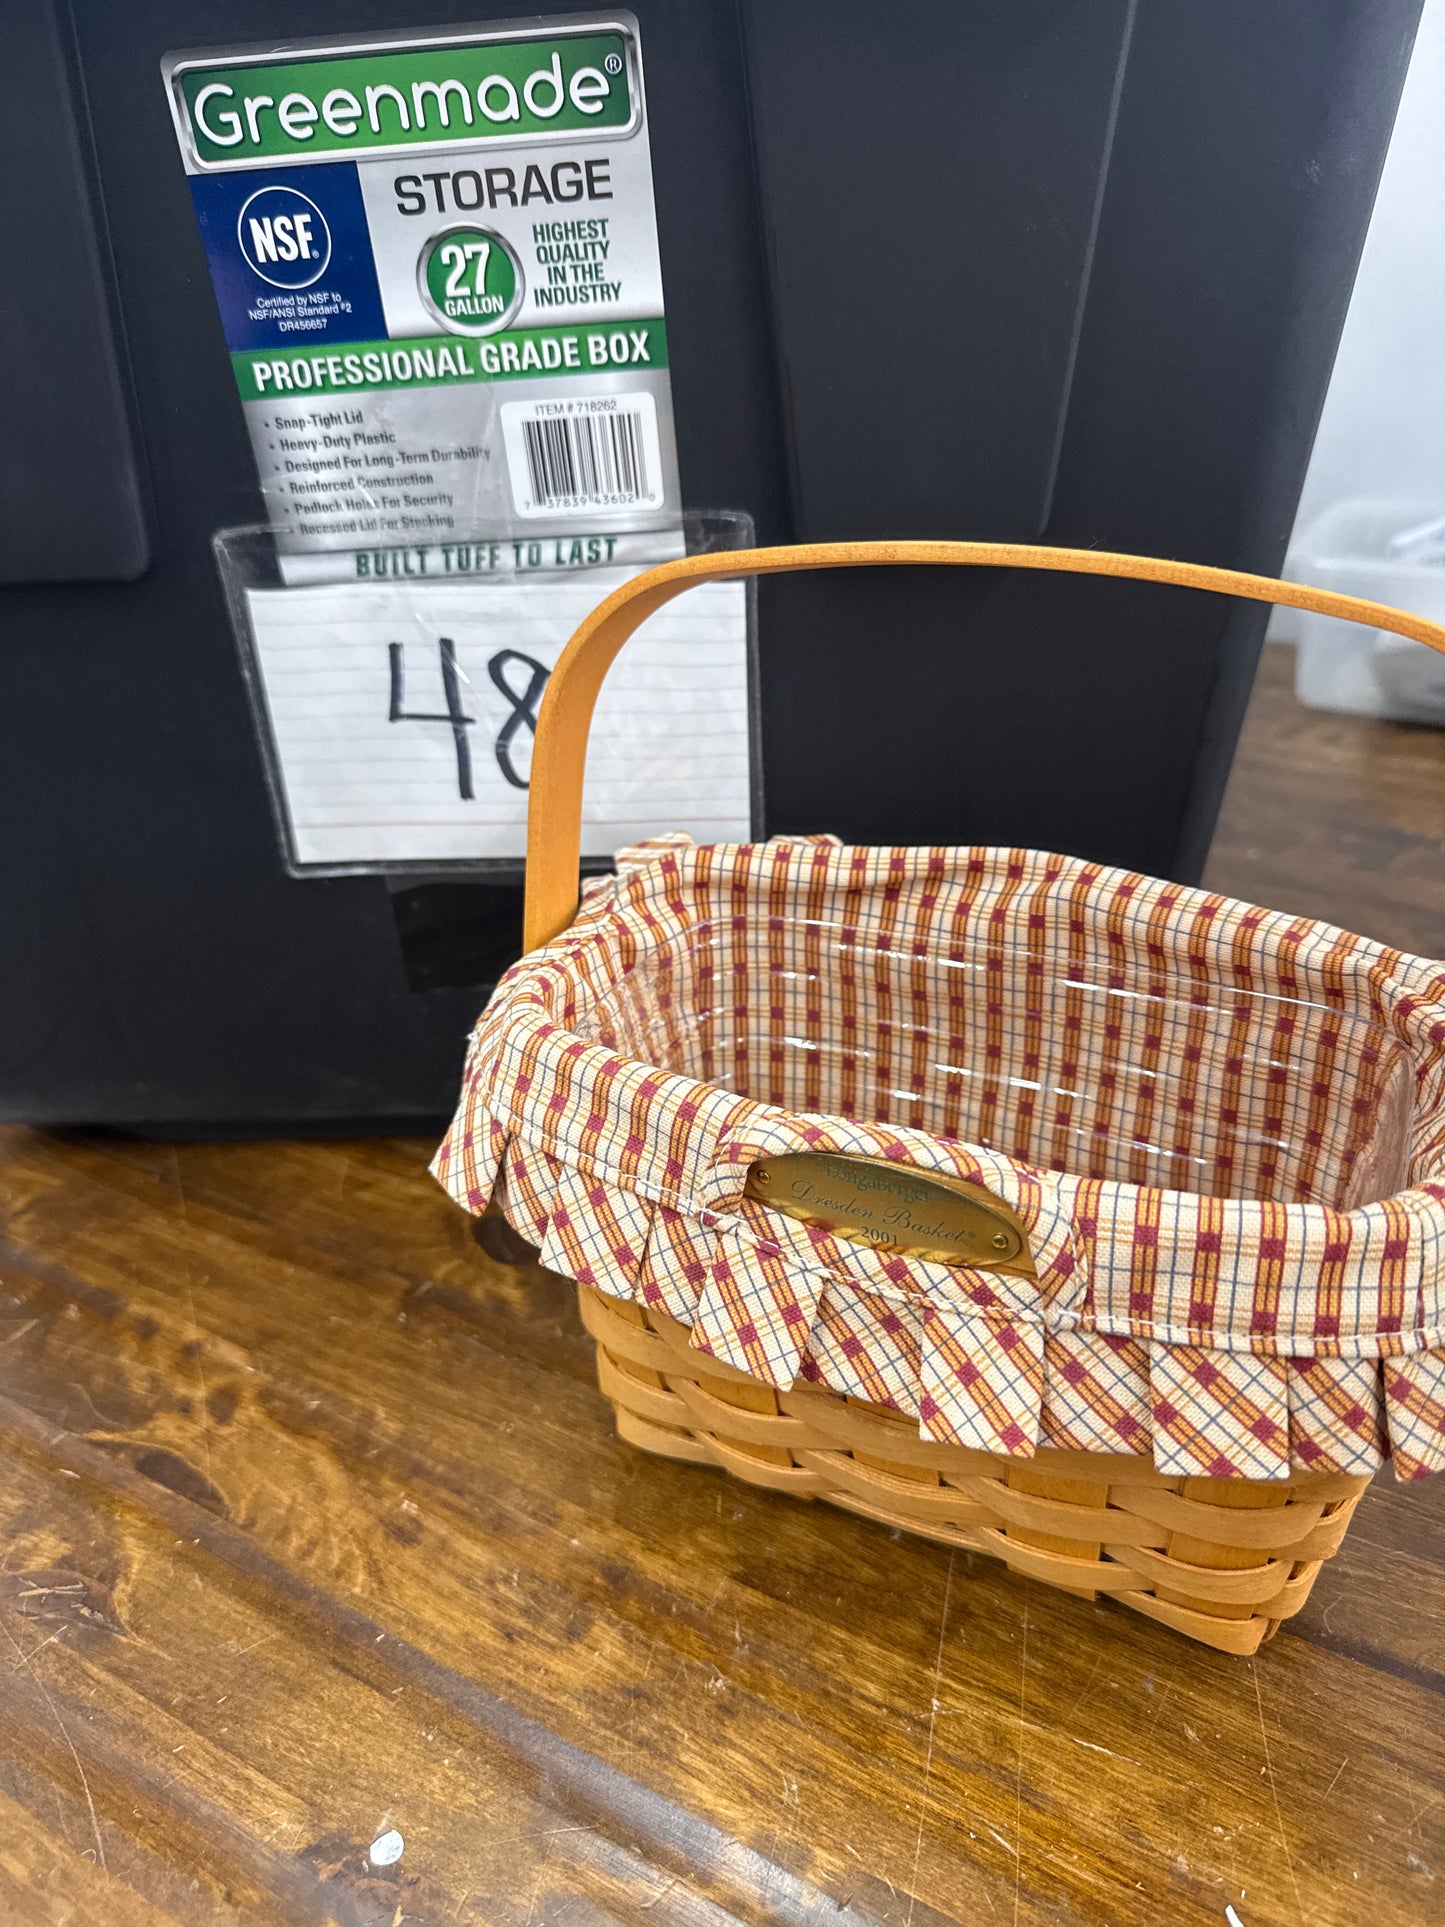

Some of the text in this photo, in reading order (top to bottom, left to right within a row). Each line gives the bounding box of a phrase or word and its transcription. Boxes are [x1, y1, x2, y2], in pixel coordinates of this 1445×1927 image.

[394, 159, 613, 216] STORAGE
[532, 218, 609, 243] HIGHEST
[536, 240, 610, 264] QUALITY
[441, 242, 490, 297] 27
[547, 262, 605, 285] IN THE
[256, 292, 341, 308] Certified by NSF to
[445, 295, 504, 316] GALLON
[534, 282, 622, 307] INDUSTRY
[249, 306, 297, 320] NSF/ANSI
[298, 303, 340, 317] Standard
[252, 331, 650, 391] PROFESSIONAL GRADE BOX
[535, 402, 565, 416] ITEM
[577, 400, 617, 413] 718262
[275, 411, 363, 431] Snap-Tight Lid
[280, 432, 397, 452] Heavy-Duty Plastic
[285, 456, 341, 473] Designed
[343, 456, 362, 468] For
[431, 446, 490, 462] Durability
[290, 473, 434, 494] Reinforced Construction
[295, 500, 343, 515] Padlock
[382, 496, 400, 509] For
[403, 493, 453, 508] Security
[355, 537, 618, 578] BUILT TUFF TO LAST
[388, 637, 552, 801] 48
[791, 1179, 875, 1219] Dresden
[861, 1226, 899, 1246] 2001
